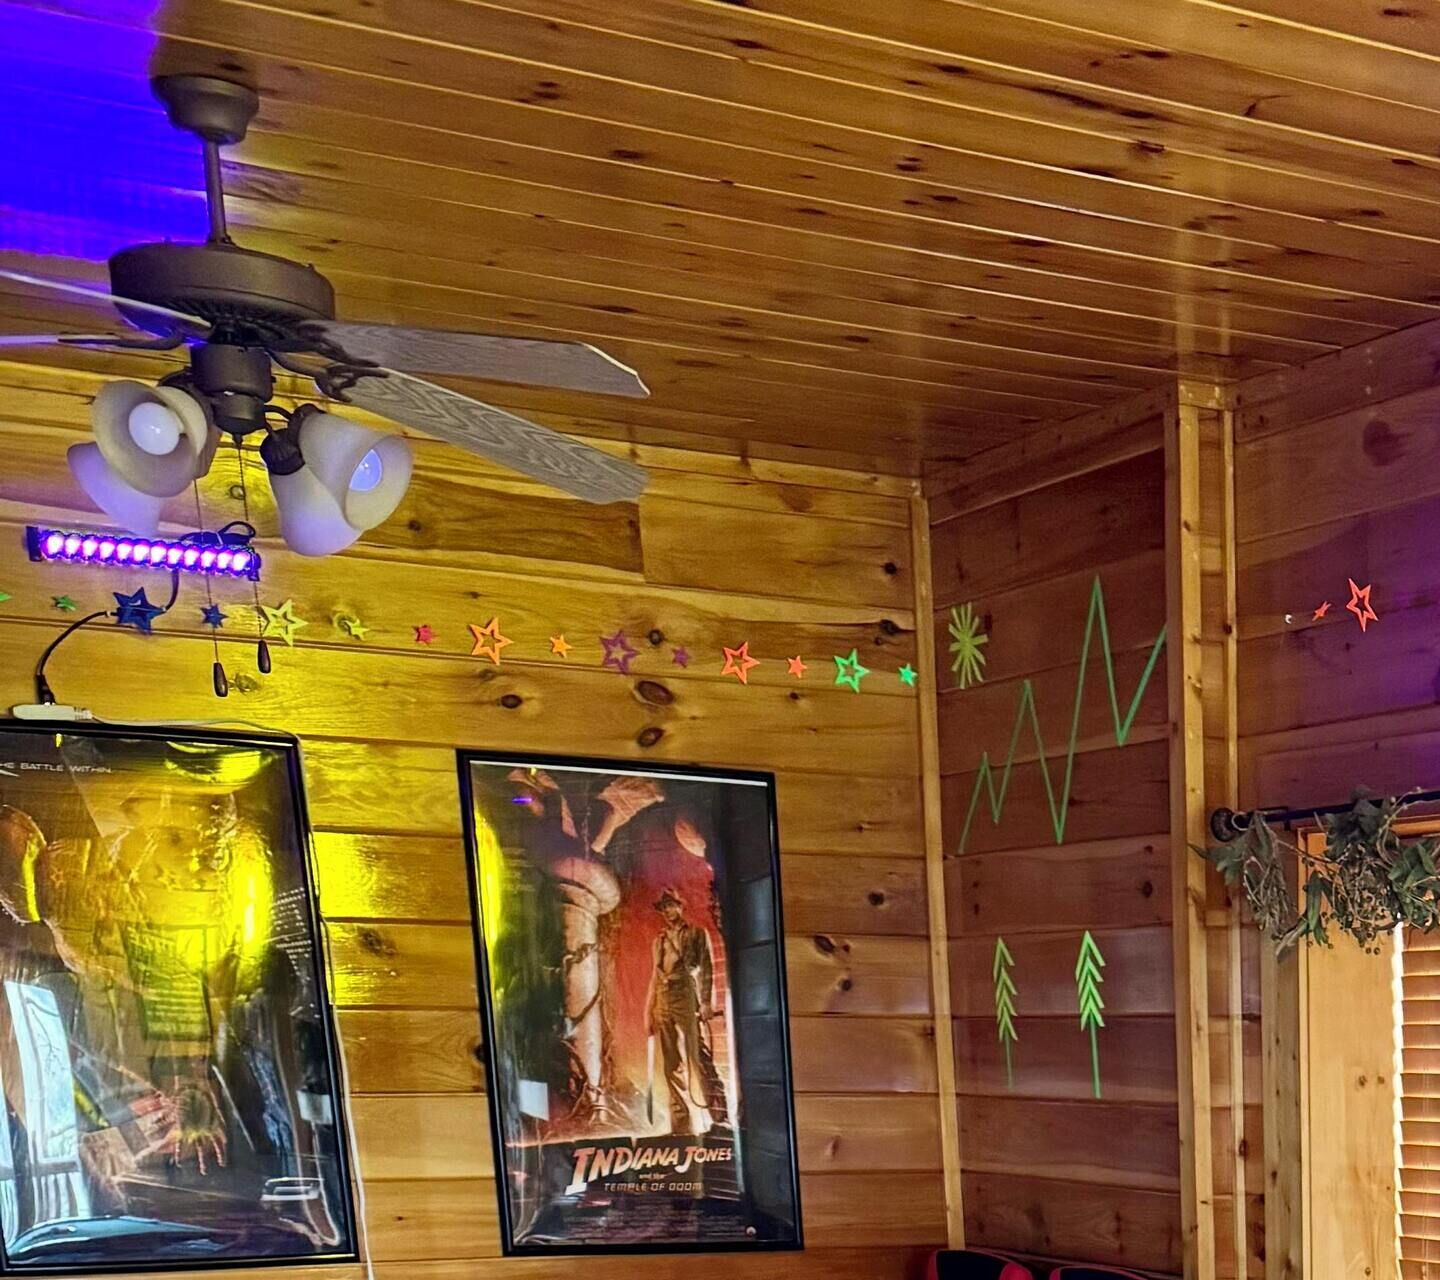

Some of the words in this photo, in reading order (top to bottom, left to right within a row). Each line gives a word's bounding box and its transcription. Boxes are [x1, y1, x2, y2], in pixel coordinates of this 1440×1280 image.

[20, 762, 64, 771] BATTLE
[564, 1145, 680, 1196] INDIANA
[674, 1145, 732, 1173] JONES
[604, 1182, 647, 1192] TEMPLE
[650, 1182, 666, 1191] OF
[669, 1182, 702, 1191] DOOM
